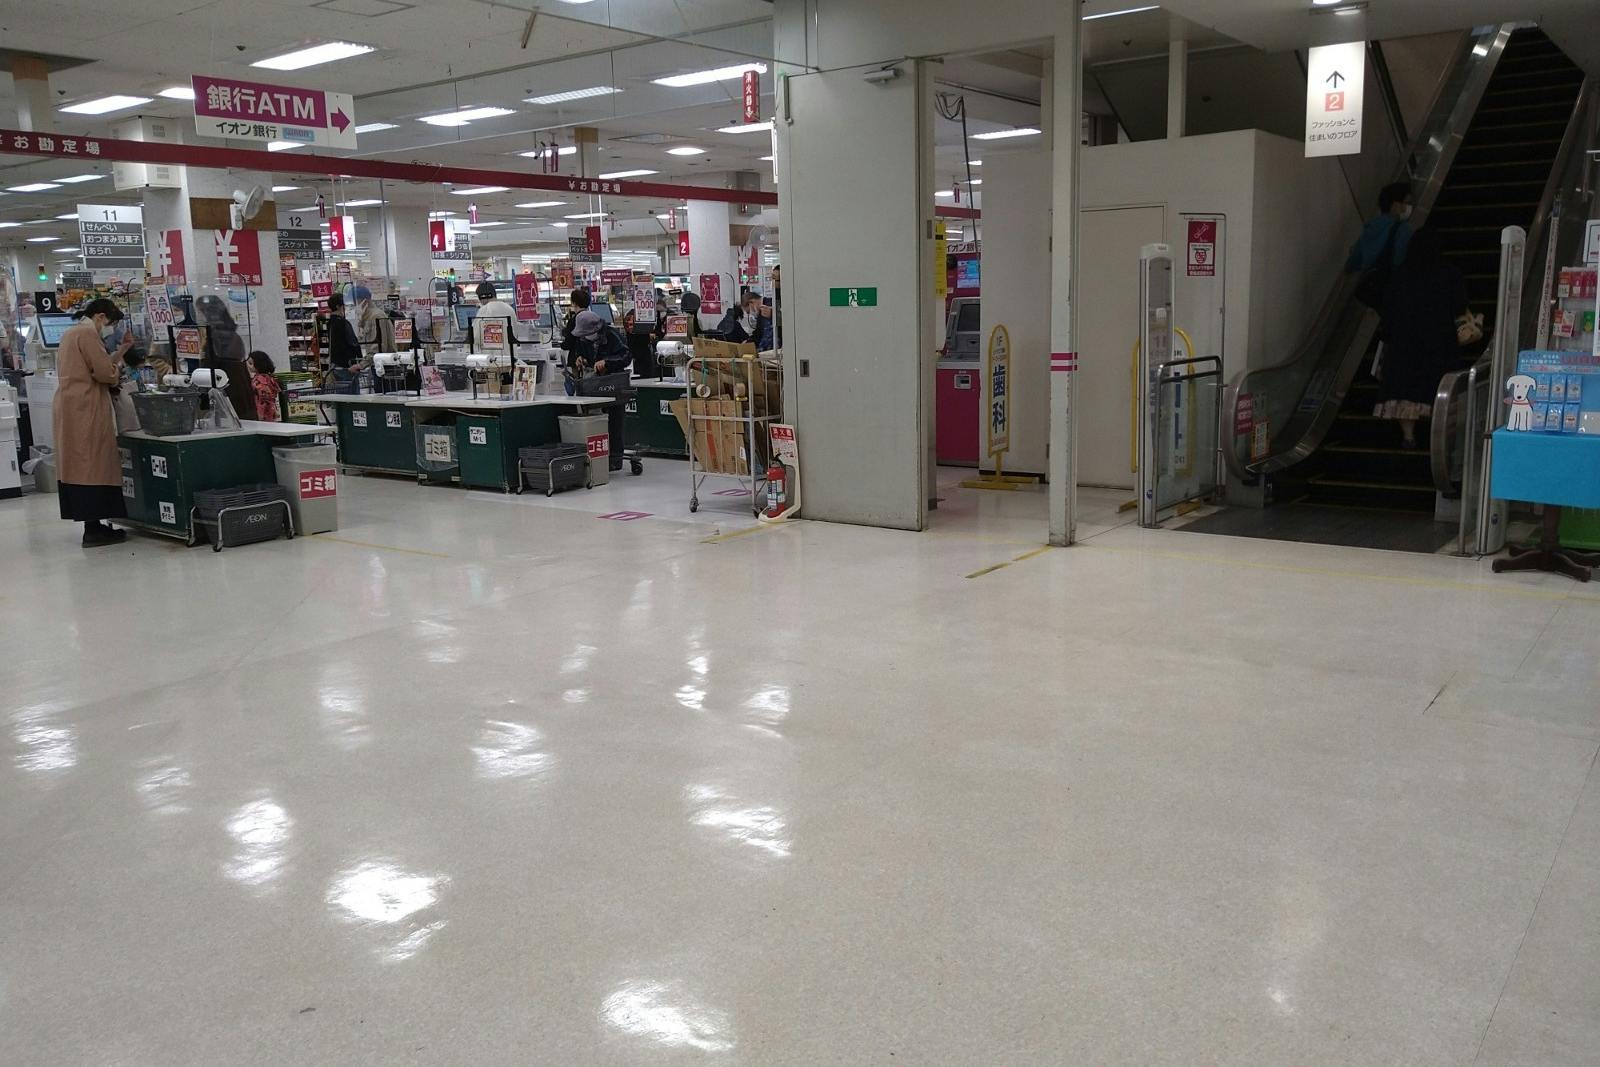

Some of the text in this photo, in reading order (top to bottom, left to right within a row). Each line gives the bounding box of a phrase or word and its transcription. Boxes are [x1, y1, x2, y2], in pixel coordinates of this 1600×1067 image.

[206, 83, 316, 120] 銀行ATM
[1328, 93, 1341, 110] 2
[215, 121, 278, 139] イオン銀行
[1312, 118, 1356, 129] ファッションと
[1309, 130, 1358, 142] 住まいのフロア
[103, 209, 117, 221] 11
[289, 216, 303, 227] 12
[85, 223, 118, 232] せんべい
[86, 235, 141, 244] おつまみ豆菓子
[331, 231, 339, 247] 5
[432, 233, 439, 248] 4
[589, 238, 595, 251] 3
[88, 247, 112, 255] あられ
[213, 229, 240, 274] ¥
[680, 241, 687, 254] 2
[946, 241, 981, 253] イオン銀
[451, 291, 458, 303] 8
[41, 297, 52, 311] 9
[635, 300, 654, 310] 1,000
[150, 310, 172, 323] 1,000
[992, 363, 1006, 434] 歯科
[426, 438, 448, 457] ゴミ箱
[588, 438, 609, 453] ゴミ箱
[301, 474, 335, 493] ゴミ箱
